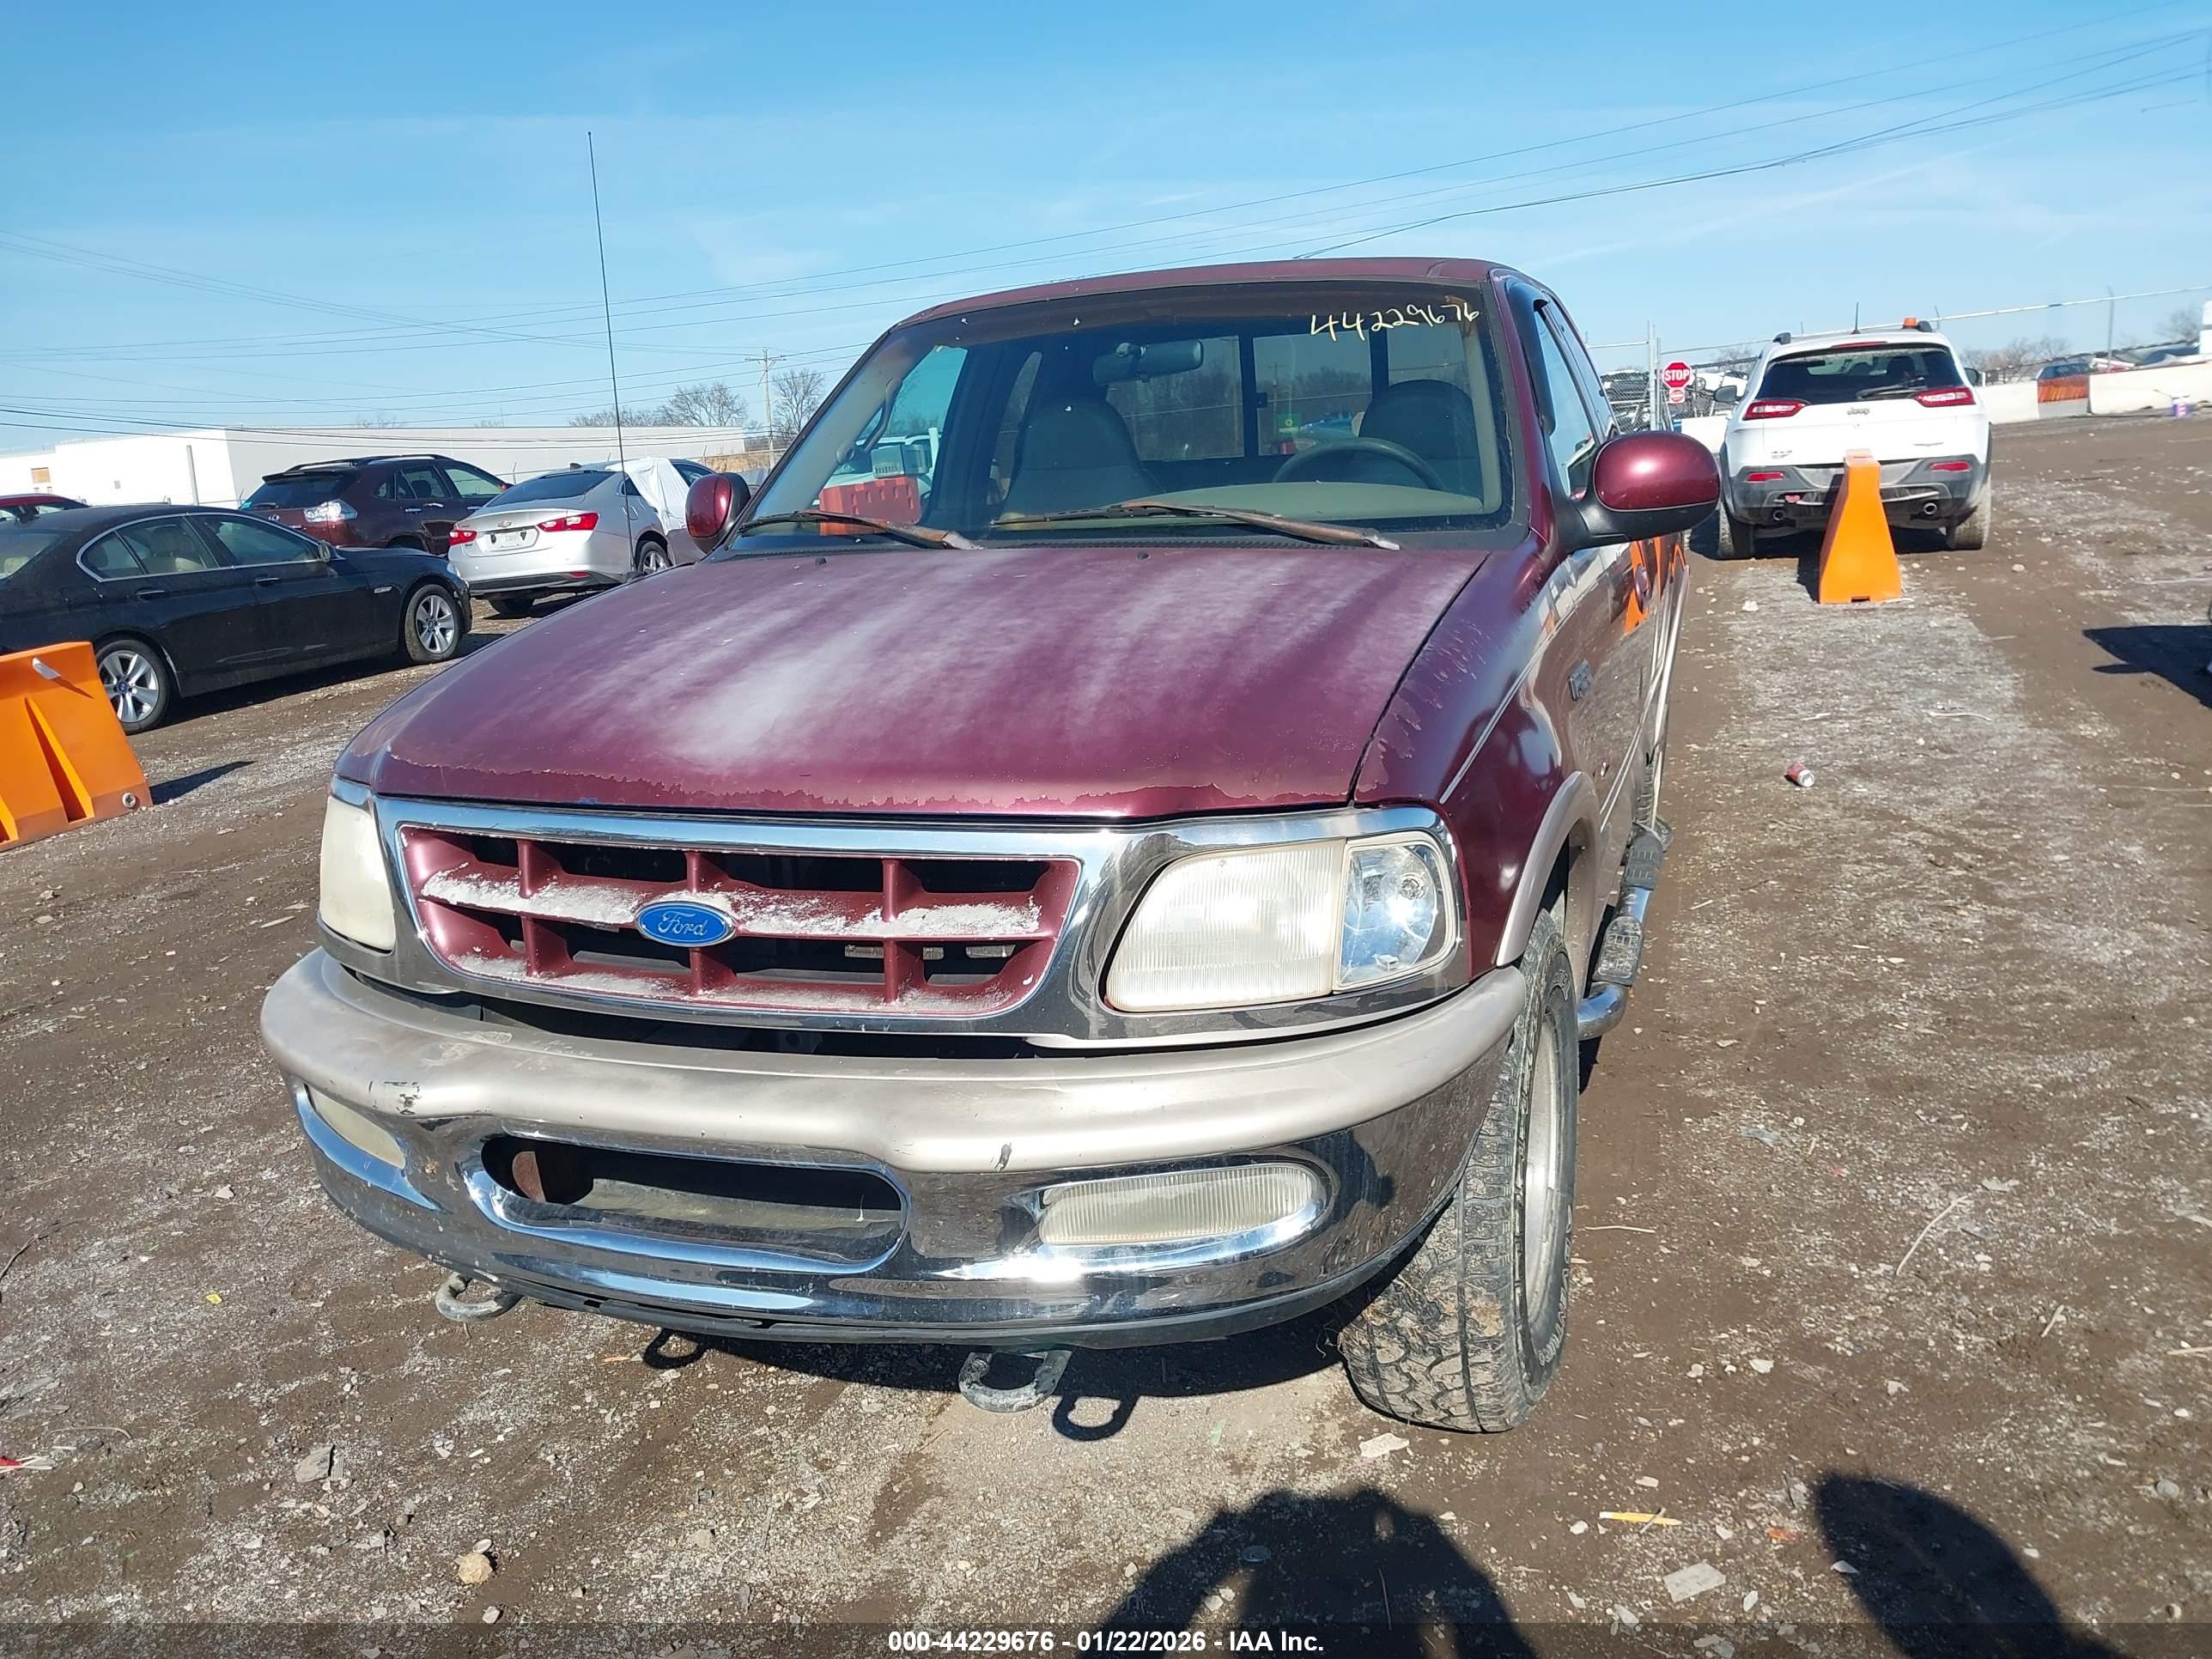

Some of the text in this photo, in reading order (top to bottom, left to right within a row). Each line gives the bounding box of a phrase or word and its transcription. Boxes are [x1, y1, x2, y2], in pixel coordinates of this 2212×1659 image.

[1310, 303, 1480, 342] 44229676
[1665, 369, 1690, 381] STOP
[658, 910, 708, 936] Ford
